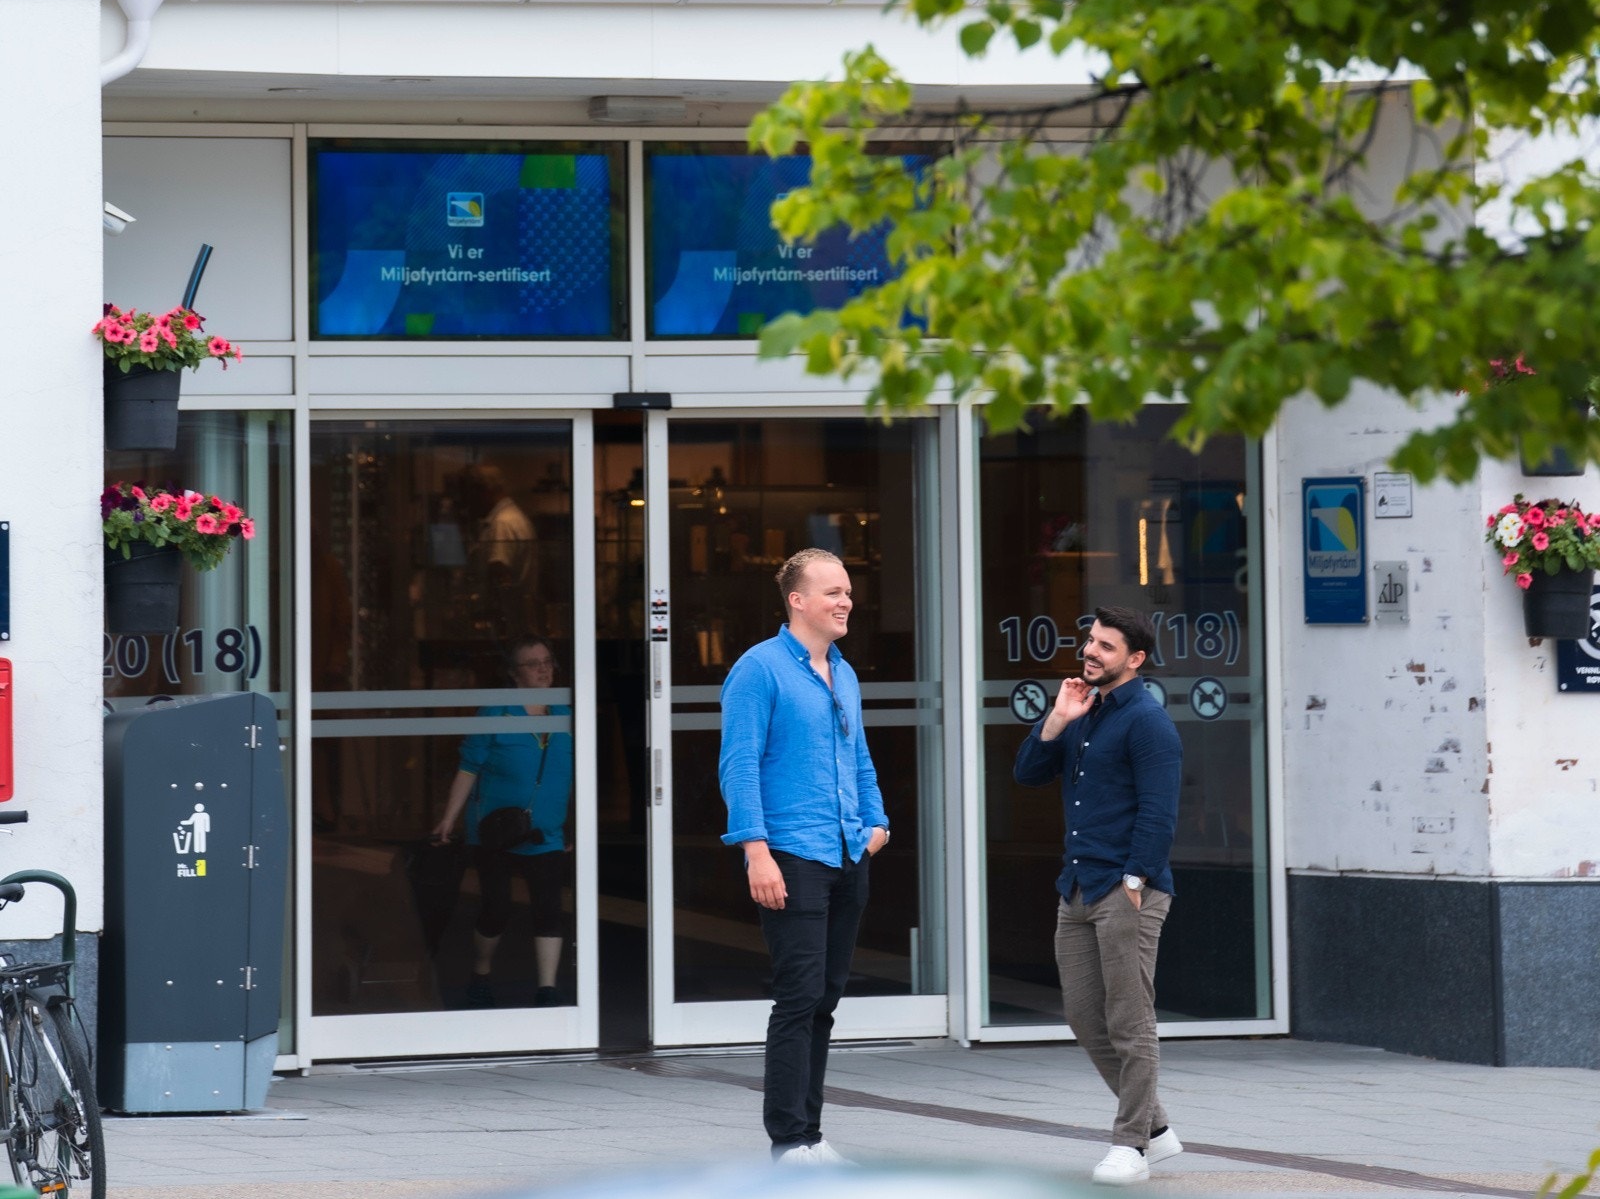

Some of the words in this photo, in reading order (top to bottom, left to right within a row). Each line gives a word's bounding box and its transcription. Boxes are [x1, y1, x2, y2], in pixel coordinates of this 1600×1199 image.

[447, 244, 463, 259] Vi
[467, 248, 484, 259] er
[777, 244, 793, 259] Vi
[796, 248, 813, 259] er
[381, 266, 551, 285] Miljøfyrtårn-sertifisert
[714, 266, 878, 285] Miljøfyrtårn-sertifisert
[999, 615, 1097, 662] 10-
[1152, 611, 1240, 666] (18)
[162, 625, 262, 684] (18)
[177, 869, 197, 877] FILL
